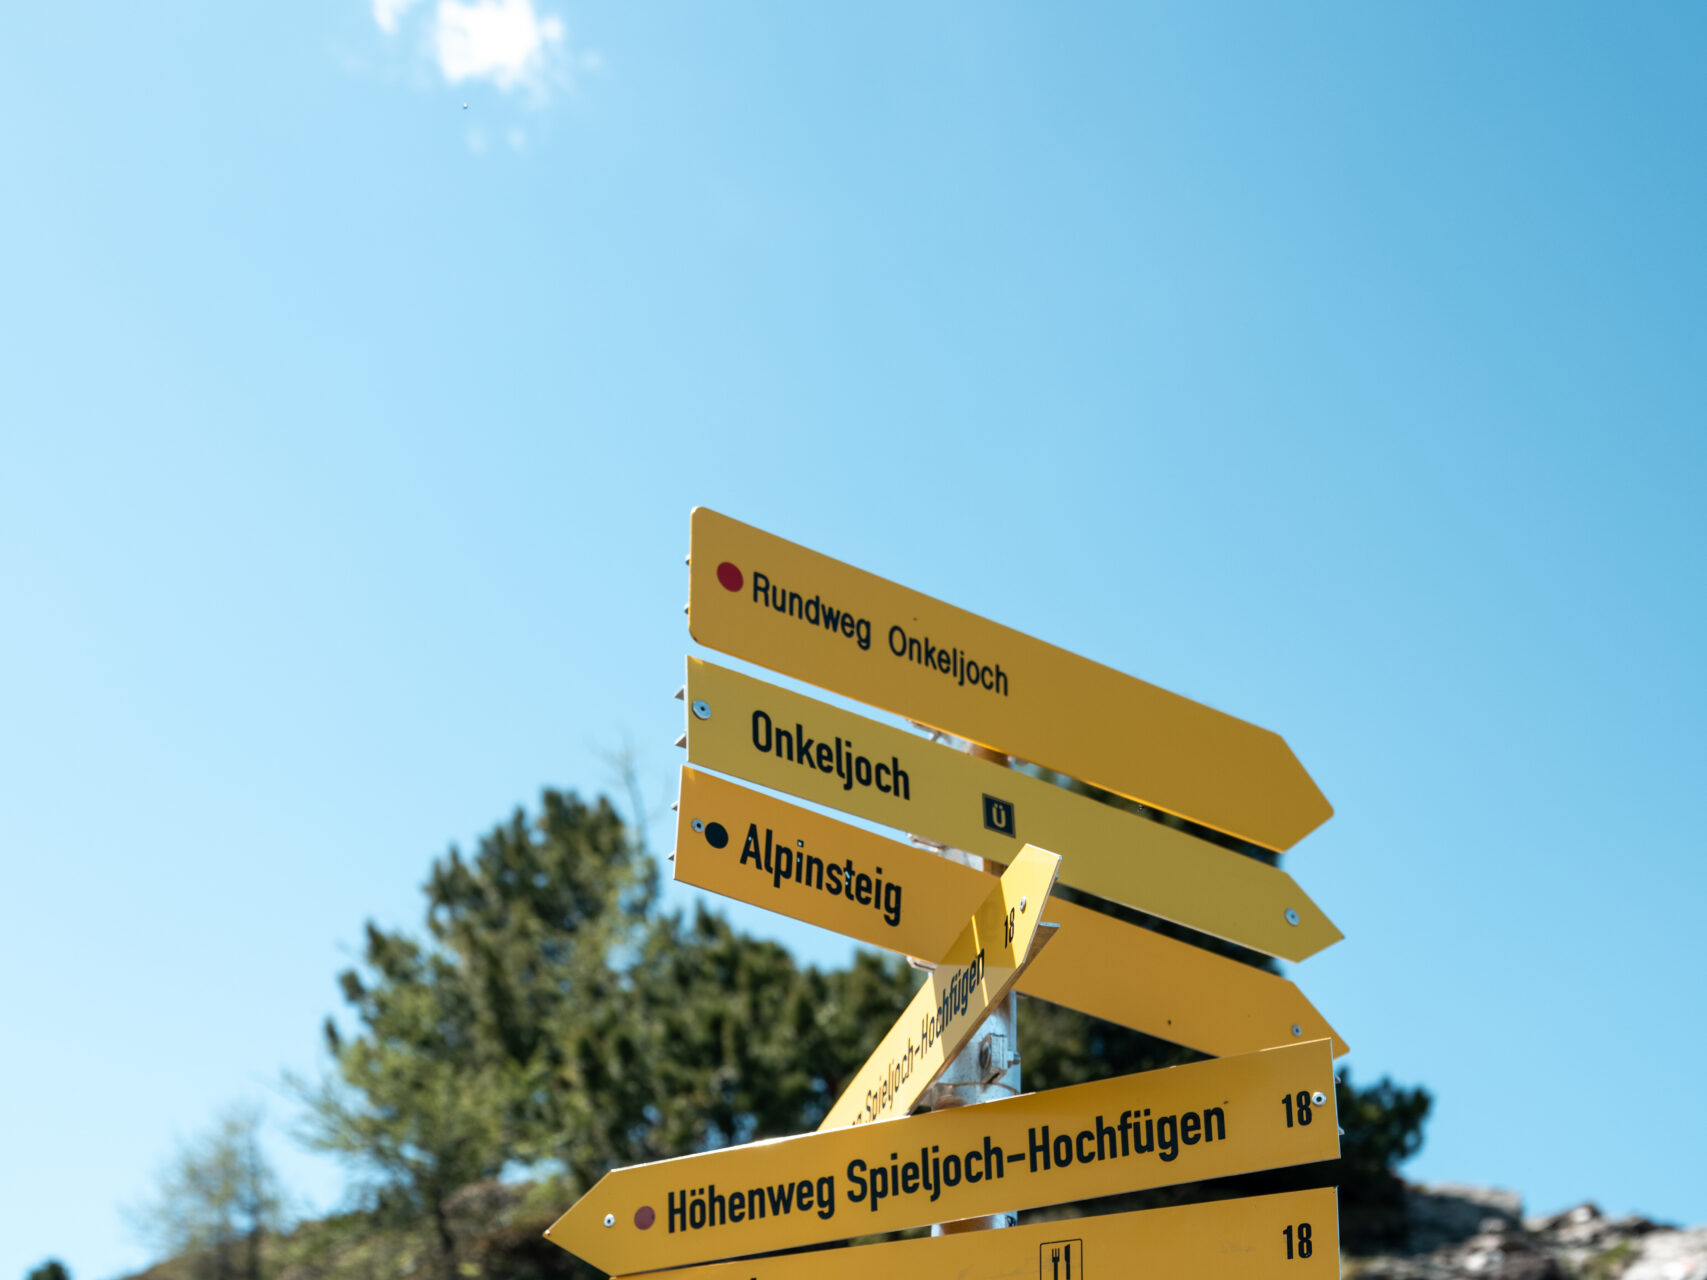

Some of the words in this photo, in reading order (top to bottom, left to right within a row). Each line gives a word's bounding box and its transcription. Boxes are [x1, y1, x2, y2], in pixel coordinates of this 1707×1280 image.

[753, 571, 871, 651] Rundweg
[888, 625, 1008, 697] Onkeljoch
[752, 710, 910, 801] Onkeljoch
[739, 823, 902, 927] Alpinsteig
[1004, 908, 1015, 948] 18
[1281, 1090, 1313, 1128] 18
[668, 1175, 835, 1234] Höhenweg
[847, 1108, 1227, 1202] Spieljoch-Hochfügen
[1282, 1222, 1313, 1260] 18
